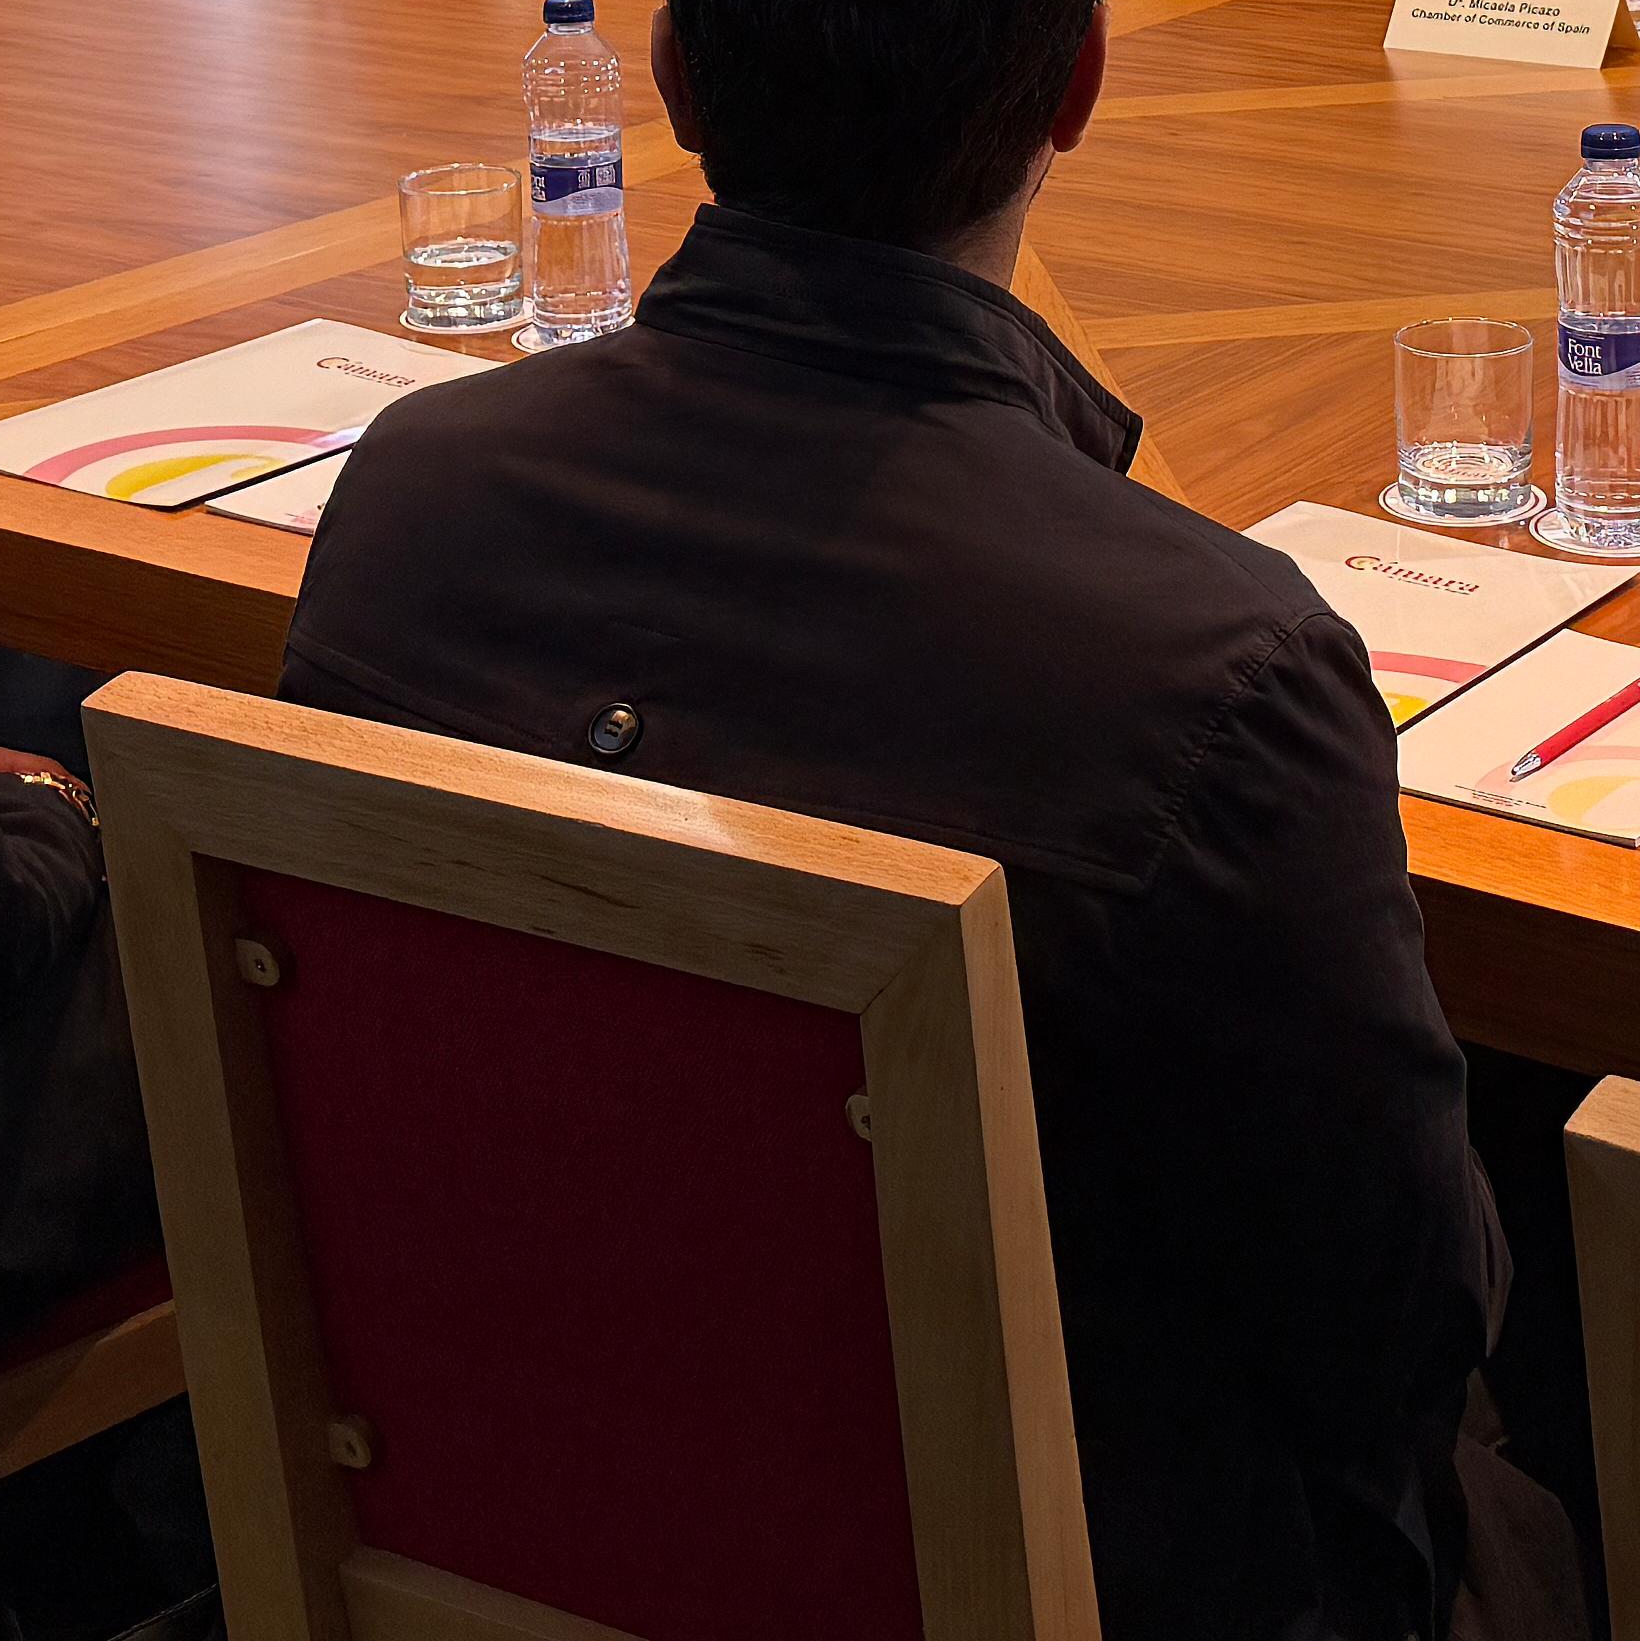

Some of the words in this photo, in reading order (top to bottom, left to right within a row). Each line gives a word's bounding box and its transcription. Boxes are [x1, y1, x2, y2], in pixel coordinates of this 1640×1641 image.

[1469, 0, 1515, 12] Micaela
[1519, 3, 1560, 16] Picazo
[1412, 9, 1461, 22] Chamber
[1465, 14, 1476, 23] of
[1479, 15, 1539, 30] Commerce
[1543, 21, 1555, 31] of
[1558, 22, 1590, 34] Spain
[1568, 338, 1601, 359] Font
[1568, 353, 1602, 375] Vella
